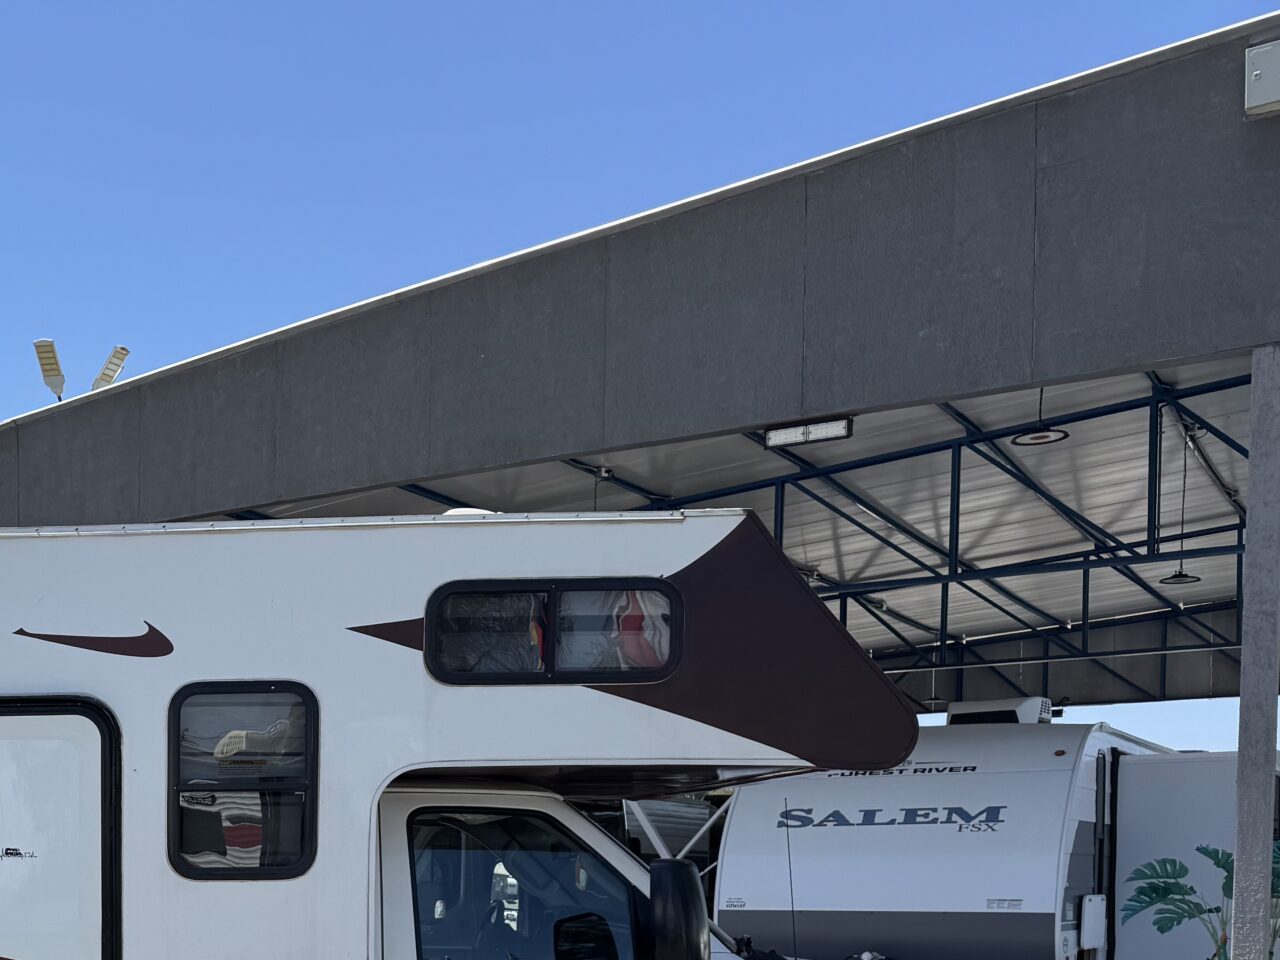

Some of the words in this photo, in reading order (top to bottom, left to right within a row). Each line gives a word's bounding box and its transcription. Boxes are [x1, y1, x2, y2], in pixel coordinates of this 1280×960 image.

[913, 766, 977, 774] RIVER
[777, 806, 1008, 828] SALEM
[957, 823, 999, 832] FSX
